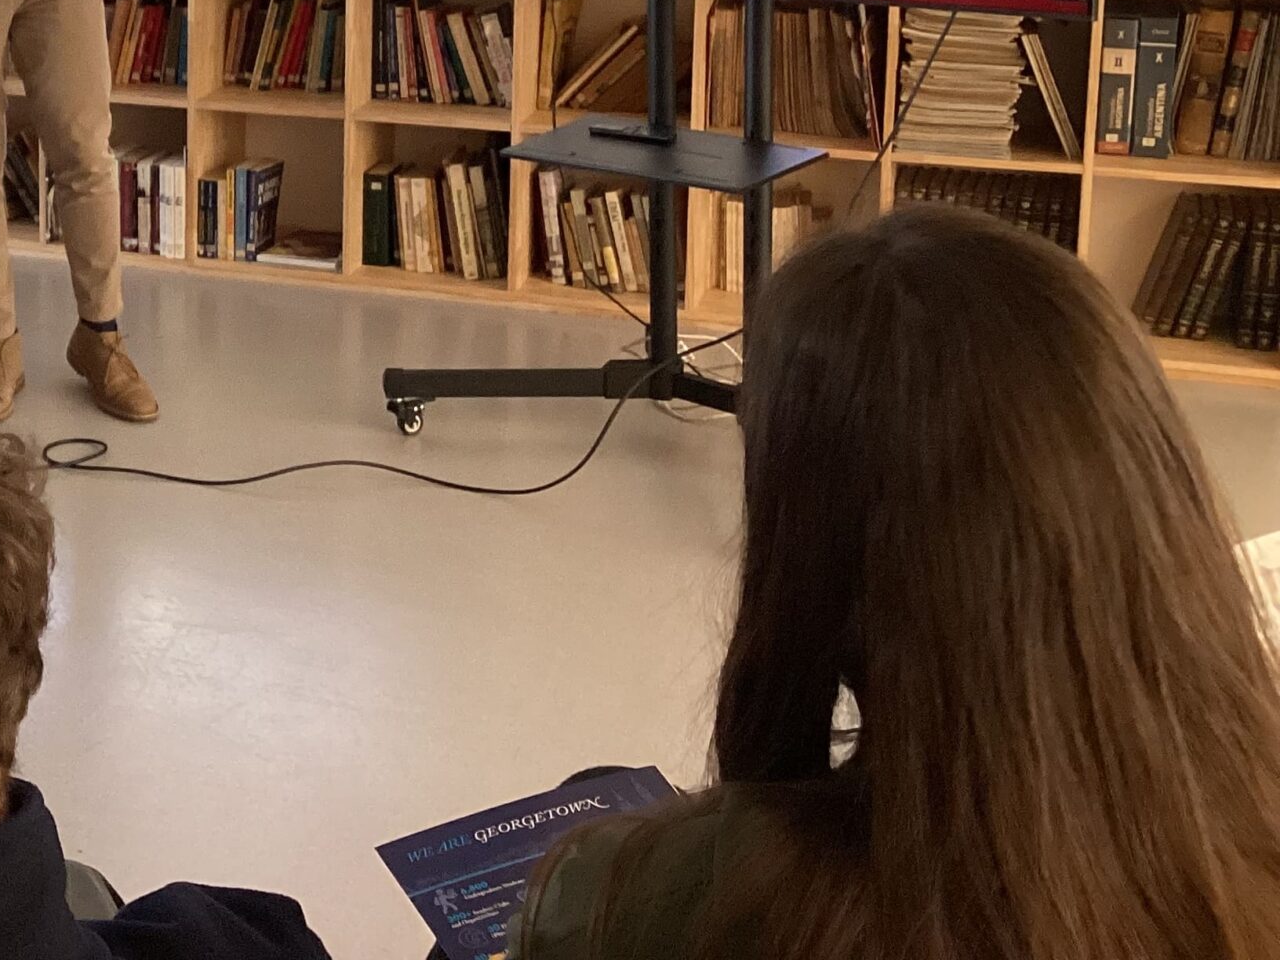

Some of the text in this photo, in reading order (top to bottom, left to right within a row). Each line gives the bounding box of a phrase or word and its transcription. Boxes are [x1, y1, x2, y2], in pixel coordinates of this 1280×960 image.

[1154, 83, 1166, 137] ARGENTINA
[406, 846, 435, 864] WE
[473, 795, 611, 844] GEORGETOWN
